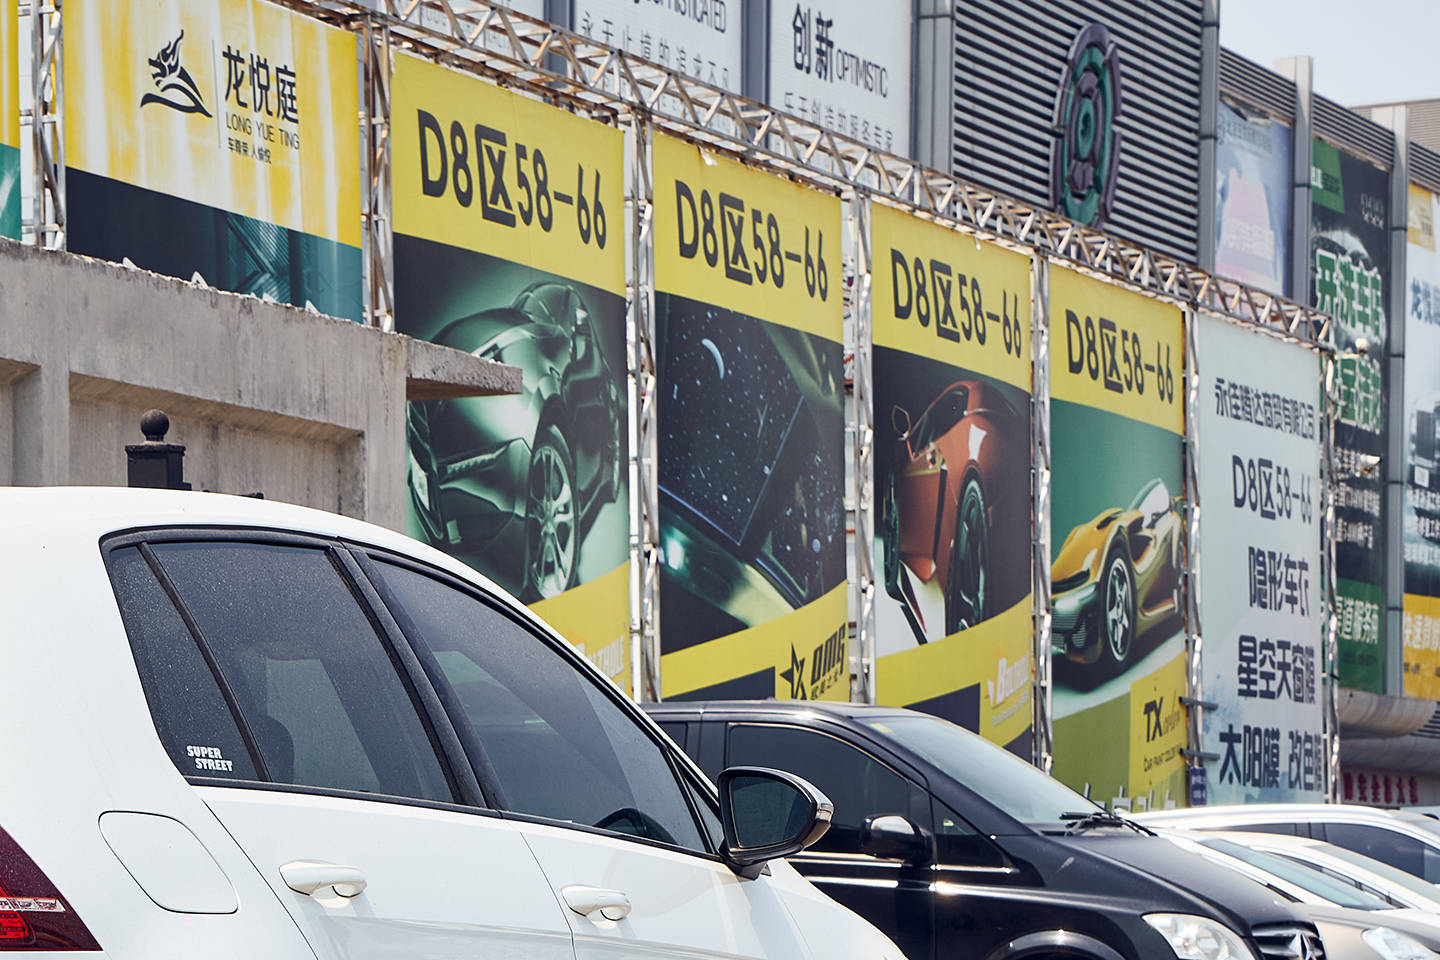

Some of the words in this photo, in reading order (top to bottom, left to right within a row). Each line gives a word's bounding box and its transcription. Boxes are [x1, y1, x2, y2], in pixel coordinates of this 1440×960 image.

[792, 3, 834, 83] 创新
[222, 45, 299, 124] 龙悦庭
[225, 111, 252, 135] LONG
[255, 120, 276, 143] YUE
[278, 127, 300, 150] TING
[417, 108, 607, 250] D8区58-66
[675, 178, 828, 302] D8区58-66
[890, 247, 1022, 359] D8区58-66
[1066, 308, 1174, 405] D8区58-66
[1232, 455, 1312, 525] D8区58-66
[1248, 546, 1309, 617] 隐形车衣
[1237, 634, 1316, 705] 星空天窗膜
[186, 745, 223, 760] SUPER
[194, 757, 233, 772] STREET
[1219, 724, 1281, 789] 太阳膜
[1288, 730, 1323, 792] 改色膜
